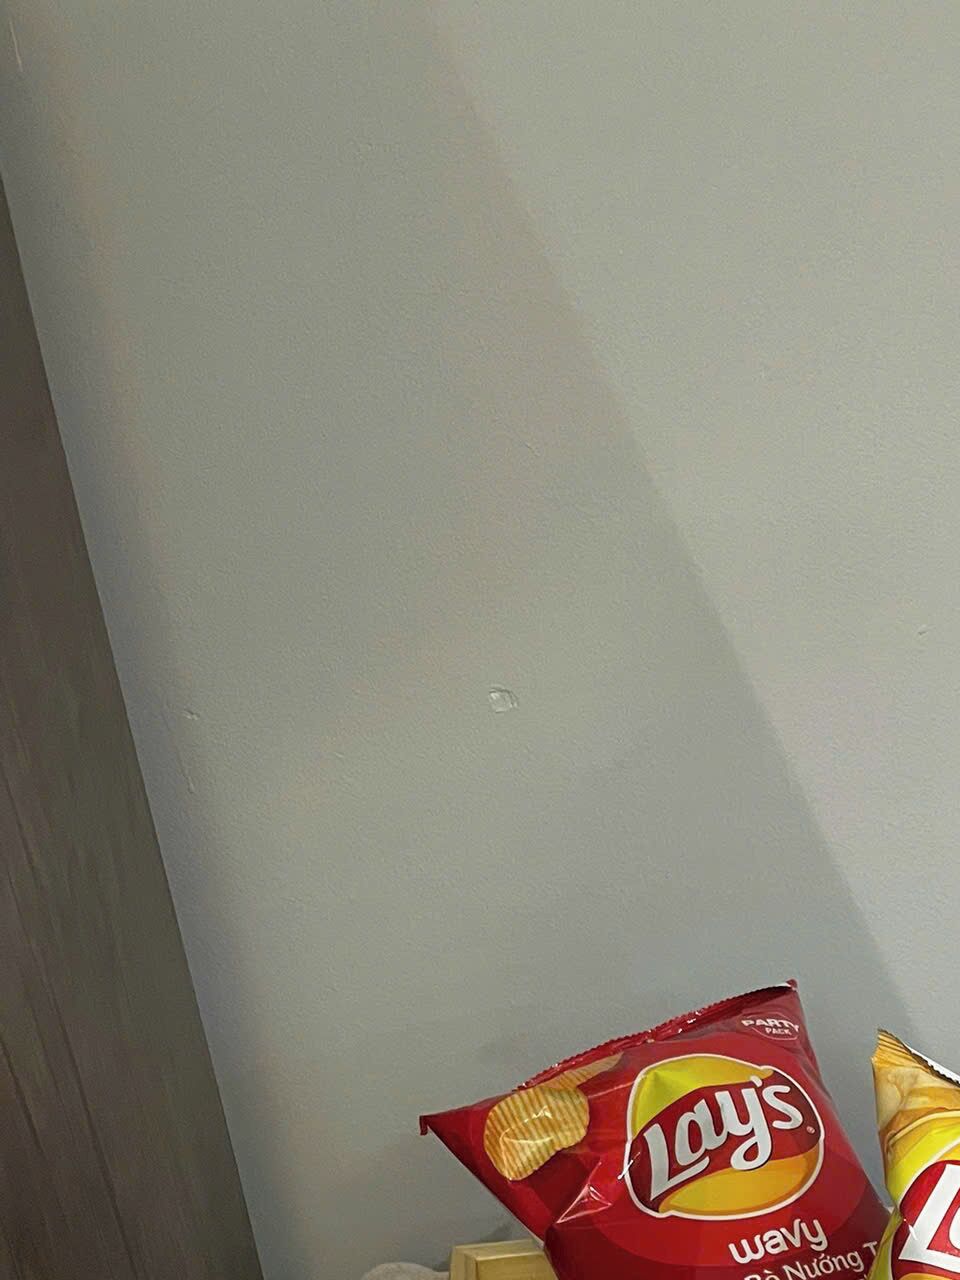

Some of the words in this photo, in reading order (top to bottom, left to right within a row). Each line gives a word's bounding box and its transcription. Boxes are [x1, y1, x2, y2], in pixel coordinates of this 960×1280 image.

[741, 1018, 799, 1032] PARTY
[765, 1027, 792, 1035] PACK
[643, 1075, 803, 1201] Lay's
[728, 1218, 829, 1265] wavy
